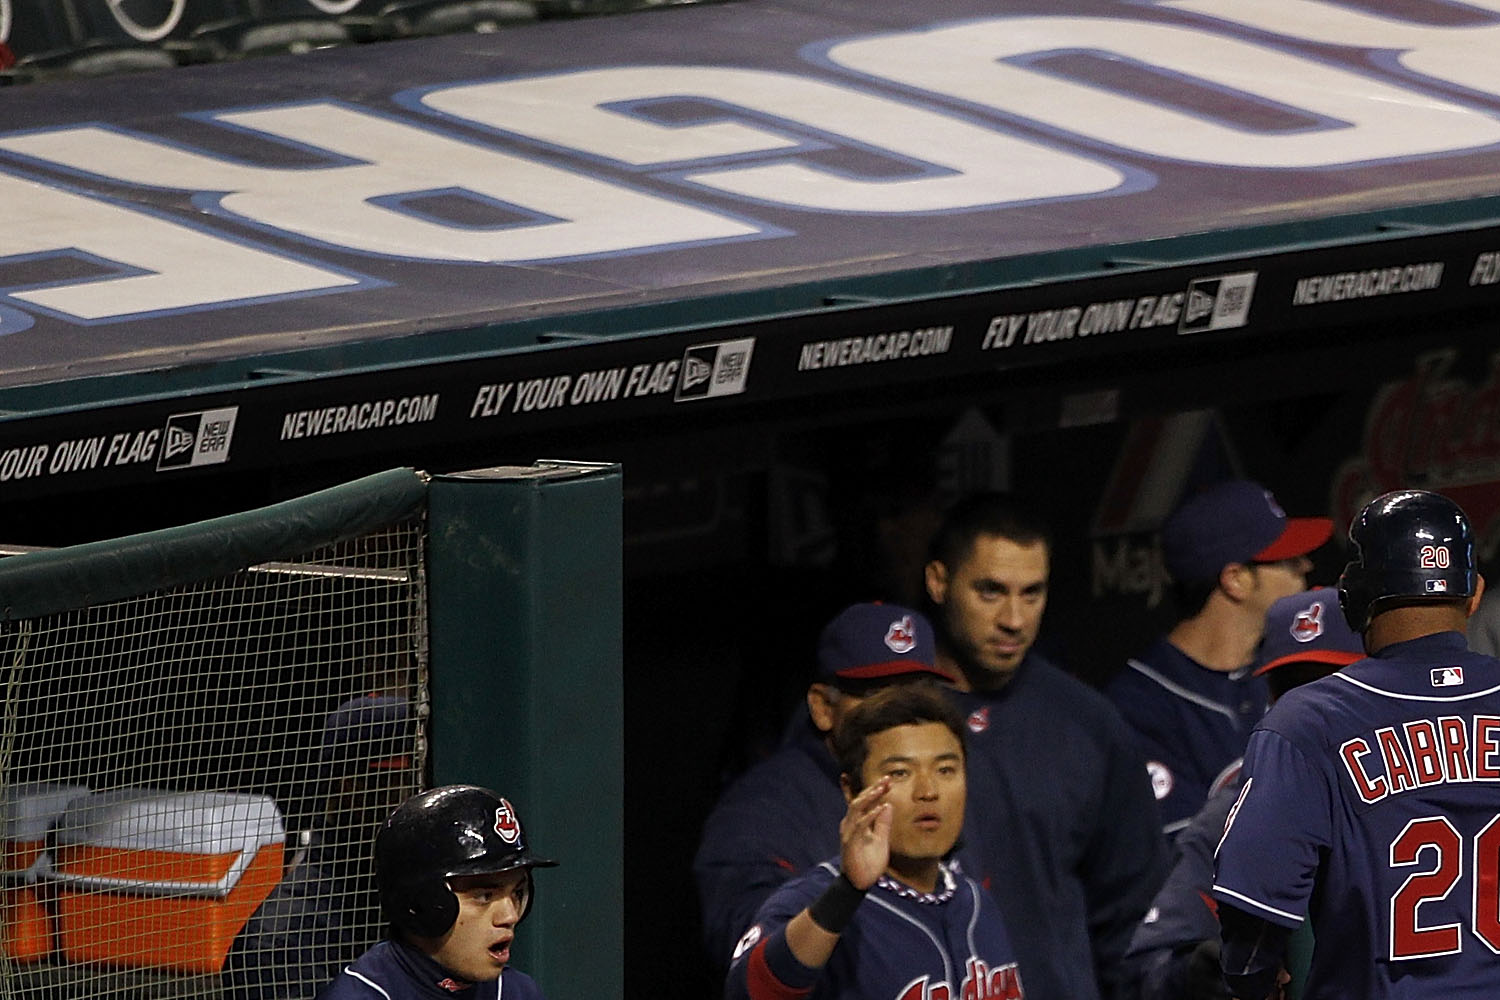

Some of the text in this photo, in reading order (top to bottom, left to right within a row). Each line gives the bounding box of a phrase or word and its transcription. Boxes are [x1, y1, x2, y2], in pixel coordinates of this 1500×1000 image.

[798, 325, 954, 371] NEWERACAP.COM
[981, 314, 1027, 350] FLY
[1023, 306, 1082, 345] YOUR
[469, 359, 681, 418] FLY YOUR OWN FLAG
[203, 420, 230, 437] NEW
[280, 393, 440, 440] NEWERACAP.COM
[49, 436, 106, 475] OWN
[104, 428, 160, 467] FLAG
[199, 436, 226, 453] ERA
[1420, 545, 1450, 569] 20
